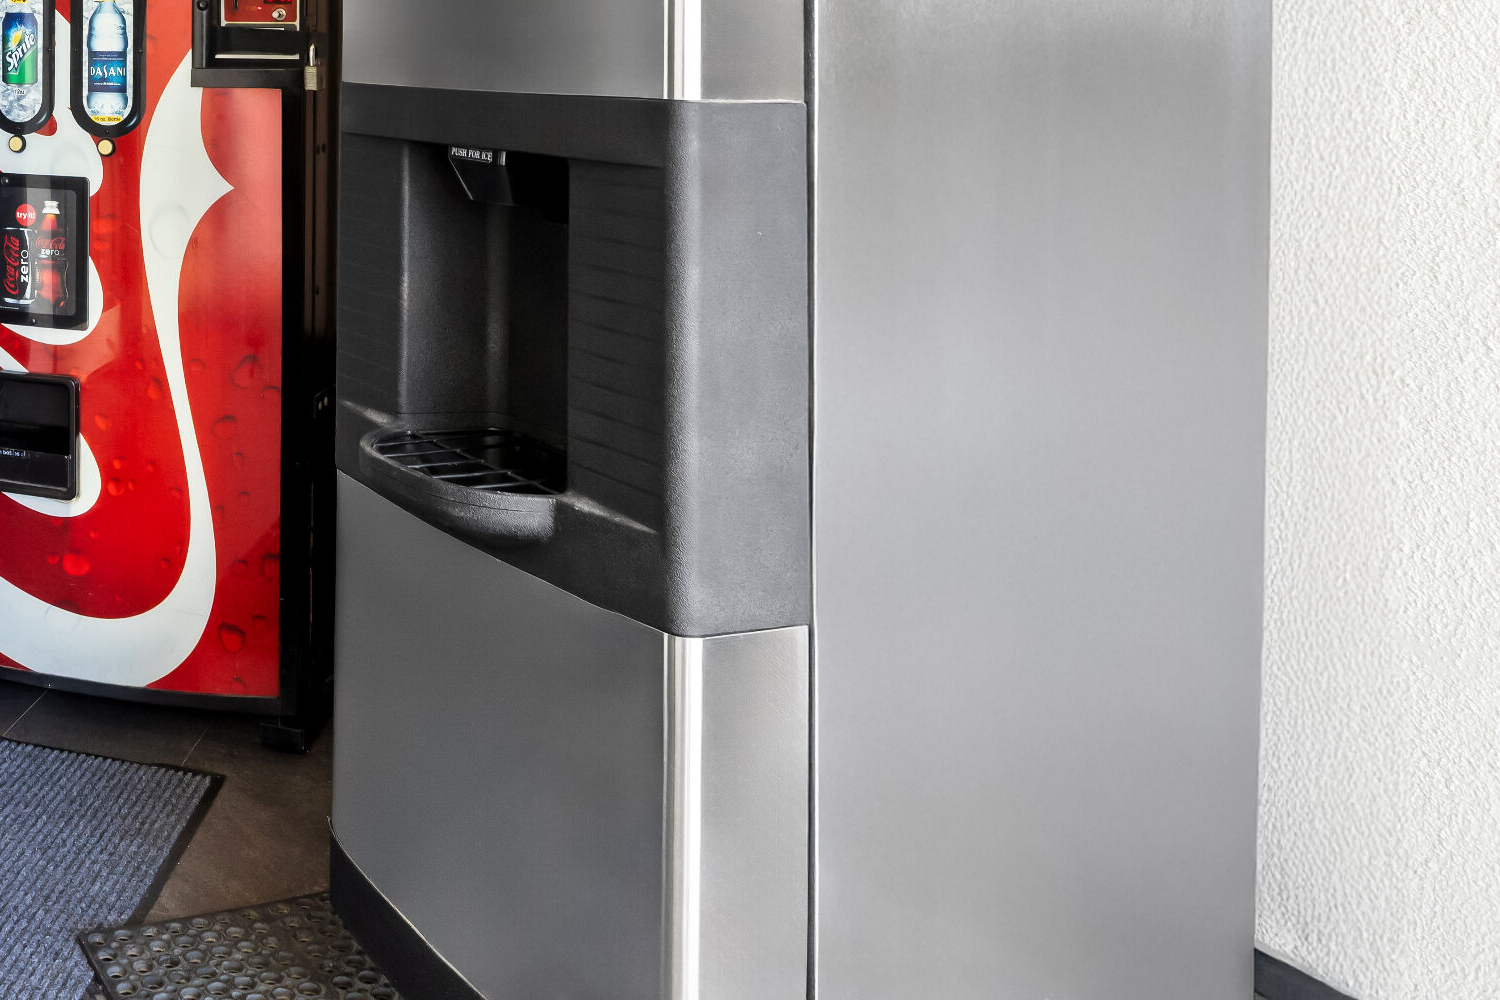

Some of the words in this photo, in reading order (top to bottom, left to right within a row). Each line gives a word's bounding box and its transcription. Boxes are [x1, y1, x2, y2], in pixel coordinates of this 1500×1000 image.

[6, 32, 37, 72] Sprite
[90, 64, 126, 79] DASANI
[451, 146, 467, 158] PUSH
[468, 148, 480, 159] FOR
[481, 151, 493, 162] ICE
[16, 211, 28, 220] try
[40, 248, 60, 256] zero
[20, 249, 29, 283] zero
